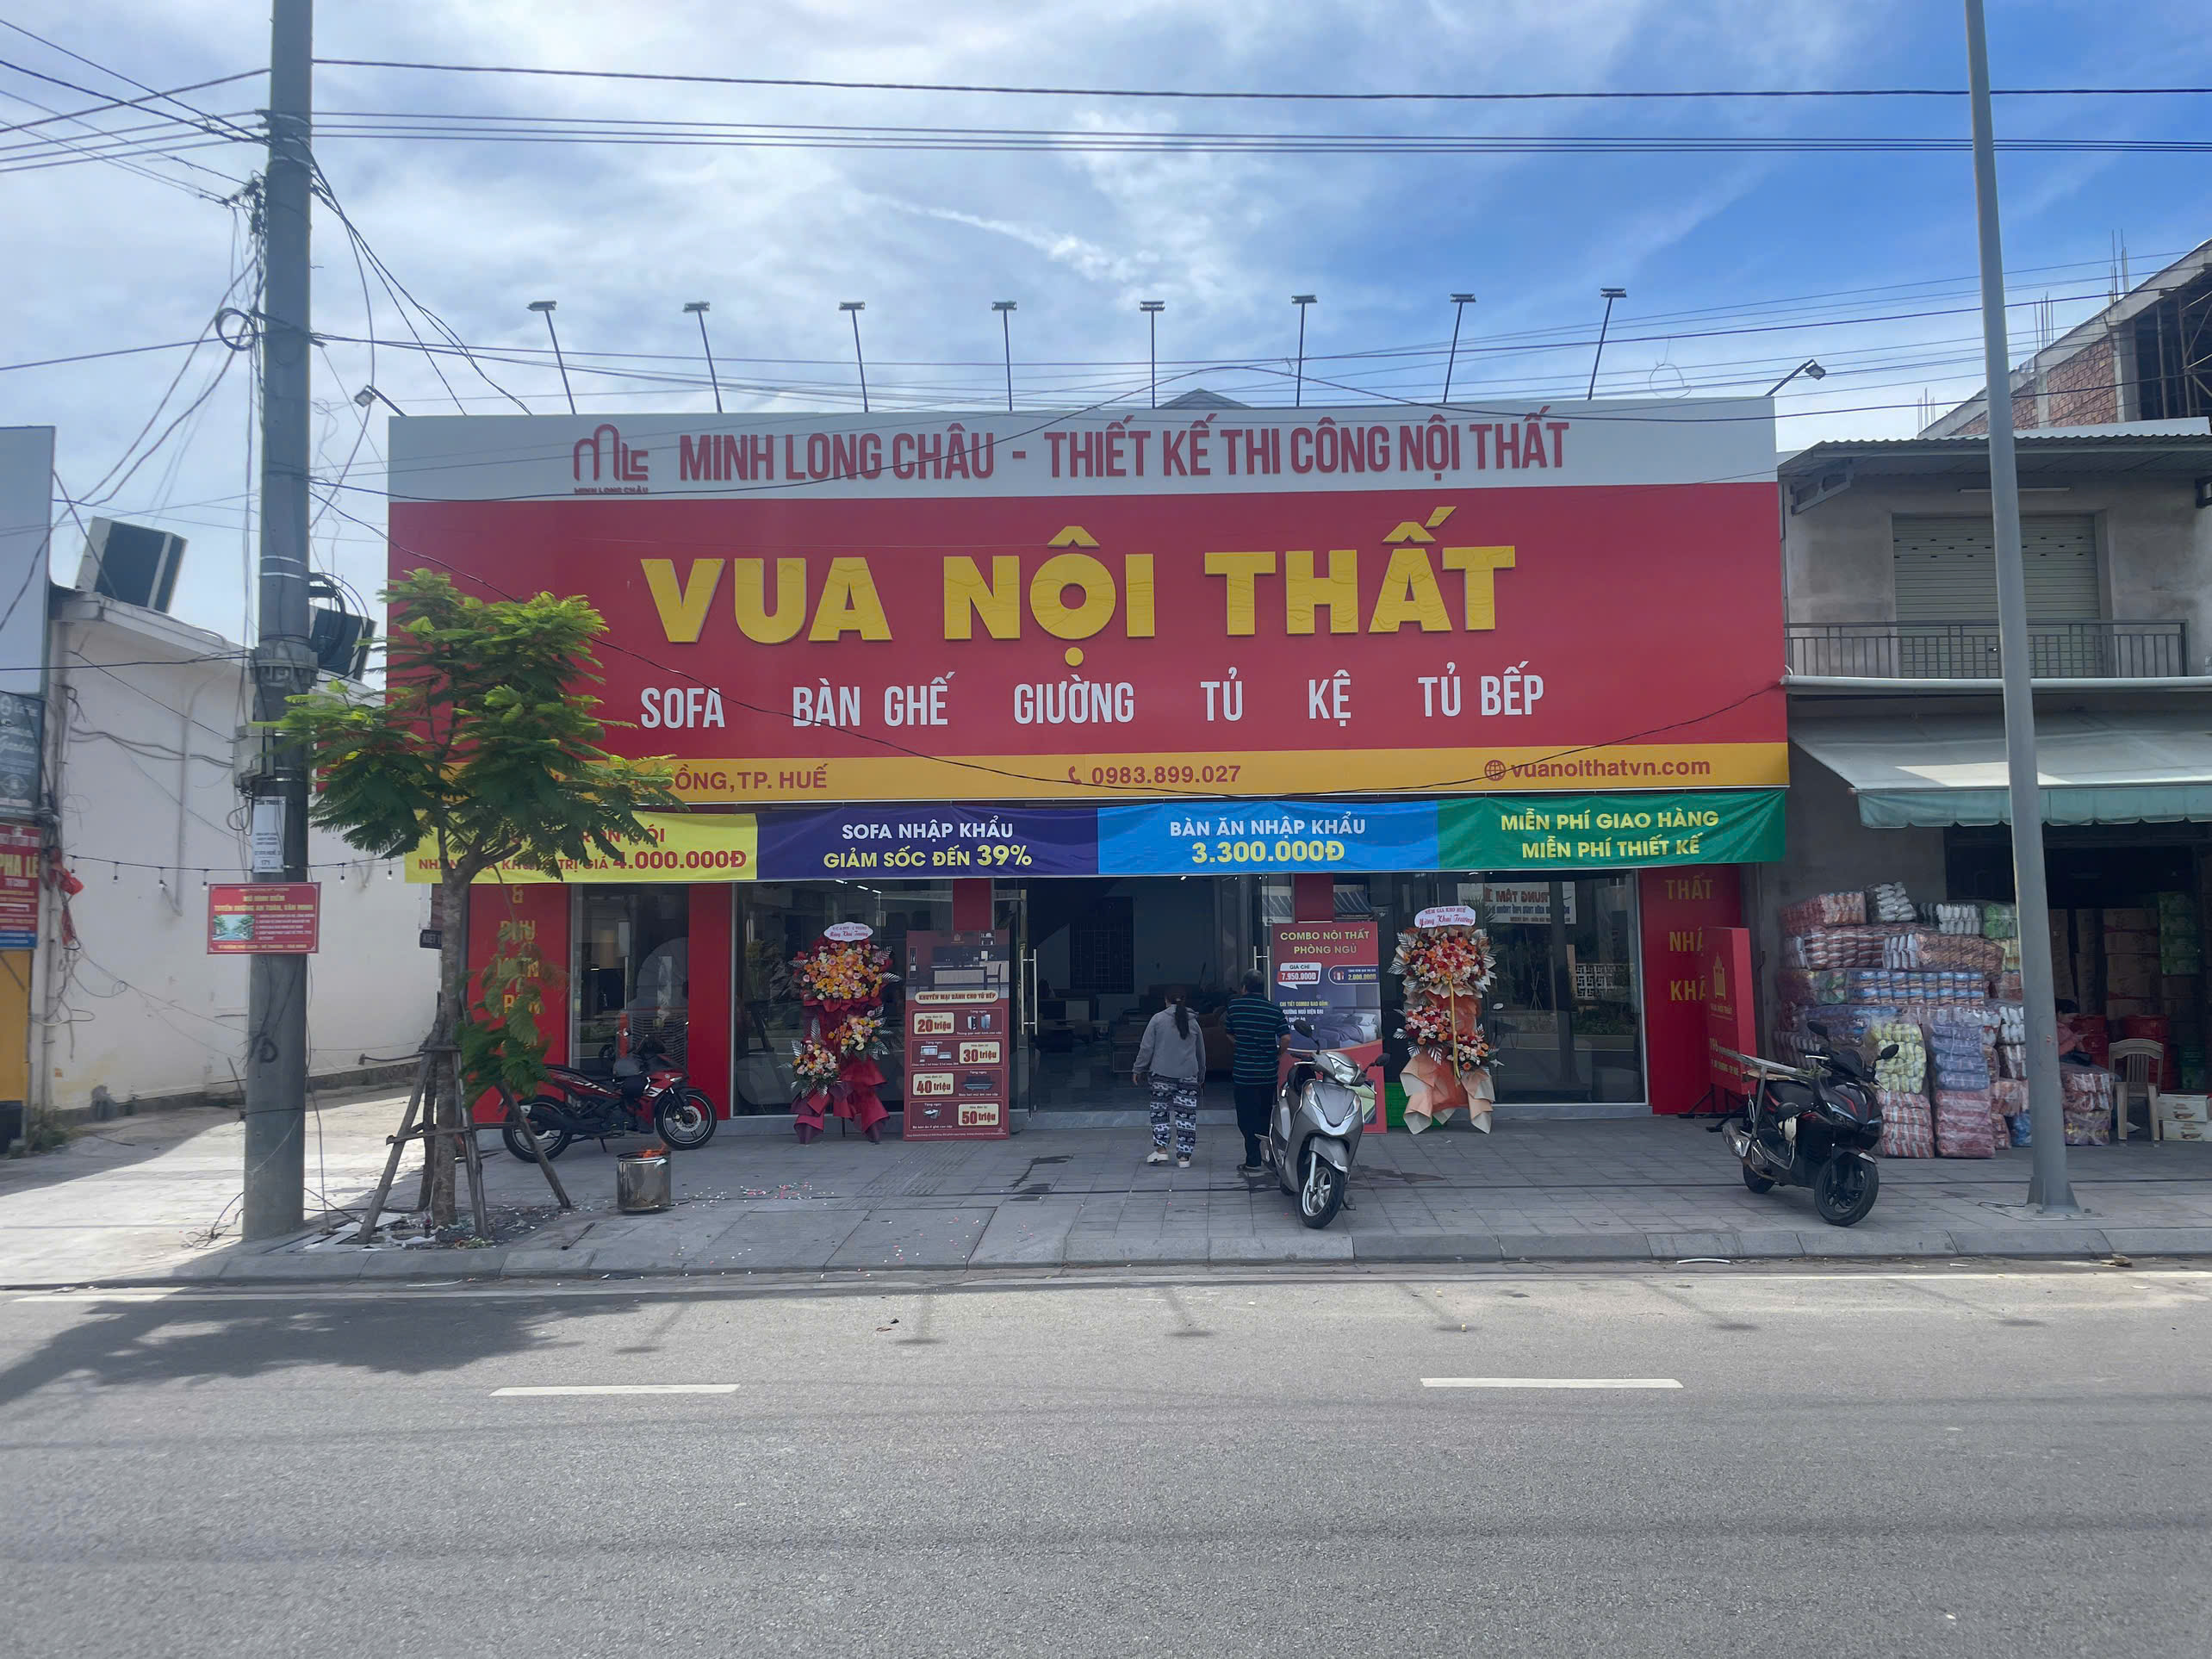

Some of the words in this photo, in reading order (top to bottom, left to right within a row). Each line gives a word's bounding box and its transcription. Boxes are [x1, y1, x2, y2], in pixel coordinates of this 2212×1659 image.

[680, 434, 774, 482] MINH
[785, 434, 883, 482] LONG
[892, 423, 995, 480] CHÂU
[1045, 415, 1151, 478] THIẾT
[1164, 413, 1217, 476] KẾ
[1221, 427, 1281, 475] THI
[1290, 417, 1390, 474] CÔNG
[1399, 414, 1461, 481] NỘI
[1469, 405, 1570, 469] THẤT
[640, 556, 893, 644] VUA
[943, 525, 1156, 667] NỘI
[1205, 506, 1516, 637] THẤT
[792, 677, 861, 727] BÀN
[884, 672, 956, 726] GHẾ
[1014, 674, 1135, 724] GIƯỜNG
[1201, 667, 1244, 722] TỦ
[1308, 669, 1351, 727] KỆ
[1419, 662, 1462, 718] TỦ
[1480, 660, 1544, 717] BẾP
[640, 687, 725, 729] SOFA
[780, 763, 829, 789] HUẾ
[1091, 765, 1241, 785] 0983.899.027
[1511, 759, 1712, 779] vuanoithatvn.com
[842, 823, 892, 841] SOFA
[898, 819, 954, 842] NHẬP
[959, 815, 1014, 839] KHẨU
[1170, 817, 1210, 837] BÀN
[1216, 817, 1245, 836] ĂN
[1251, 816, 1305, 839] NHẬP
[1312, 811, 1366, 834] KHẨU
[1501, 807, 1550, 831] MIỄN
[1557, 809, 1591, 830] PHÍ
[1596, 812, 1651, 830] GIAO
[1658, 807, 1719, 828] HÀNG
[823, 846, 878, 868] GIẢM
[883, 845, 927, 867] SỐC
[932, 844, 971, 867] ĐẾN
[977, 844, 1033, 867] 39%
[1191, 840, 1345, 864] 3.300.000Đ
[1522, 836, 1571, 859] MIỄN
[1578, 837, 1612, 857] PHÍ
[1617, 834, 1669, 857] THIẾT
[1676, 832, 1704, 855] KẾ
[558, 859, 578, 873] TRỊ
[1665, 872, 1713, 900] THẤT
[1280, 932, 1320, 941] COMBO
[1322, 929, 1342, 942] NỘI
[1345, 927, 1370, 940] THẤT
[1294, 943, 1331, 954] PHÒNG
[1334, 942, 1358, 954] NGỦ
[917, 1019, 934, 1033] 20
[934, 1021, 952, 1032] triệu
[963, 1048, 979, 1062] 30
[979, 1050, 997, 1060] triệu
[916, 1080, 933, 1094] 40
[933, 1082, 951, 1092] triệu
[961, 1110, 978, 1125] 50
[978, 1112, 997, 1123] triệu
